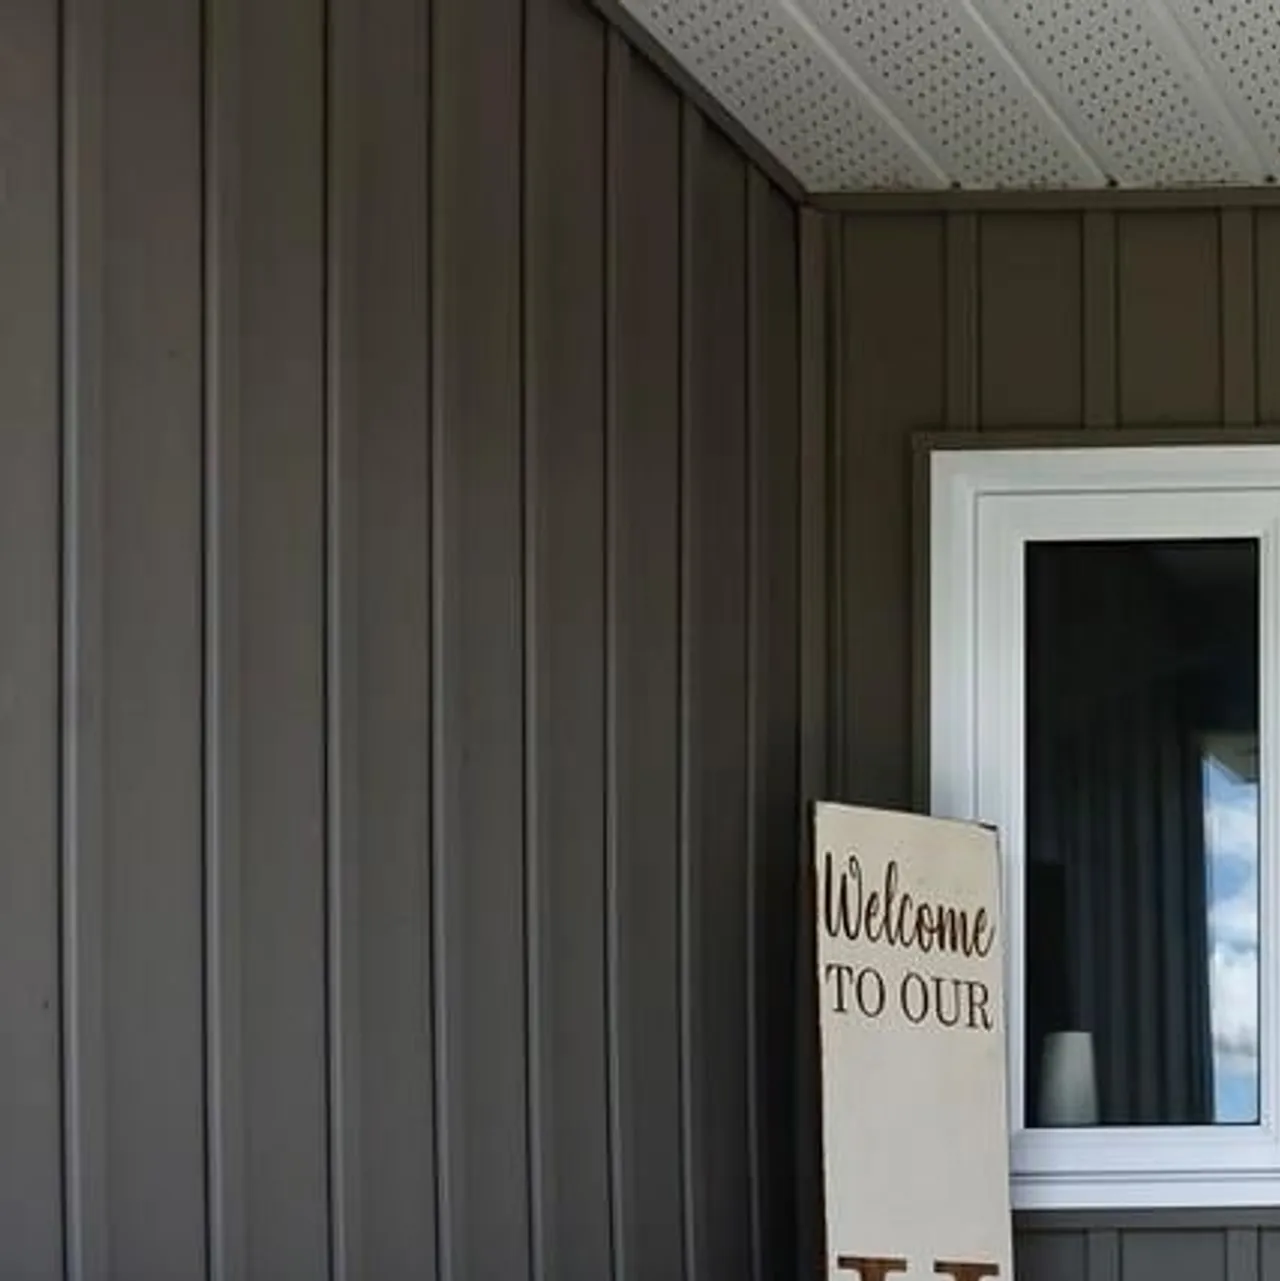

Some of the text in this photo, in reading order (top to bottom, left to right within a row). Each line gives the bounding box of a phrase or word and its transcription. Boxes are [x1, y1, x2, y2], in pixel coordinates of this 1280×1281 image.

[824, 851, 995, 958] Welcome
[825, 963, 994, 1032] TO OUR
